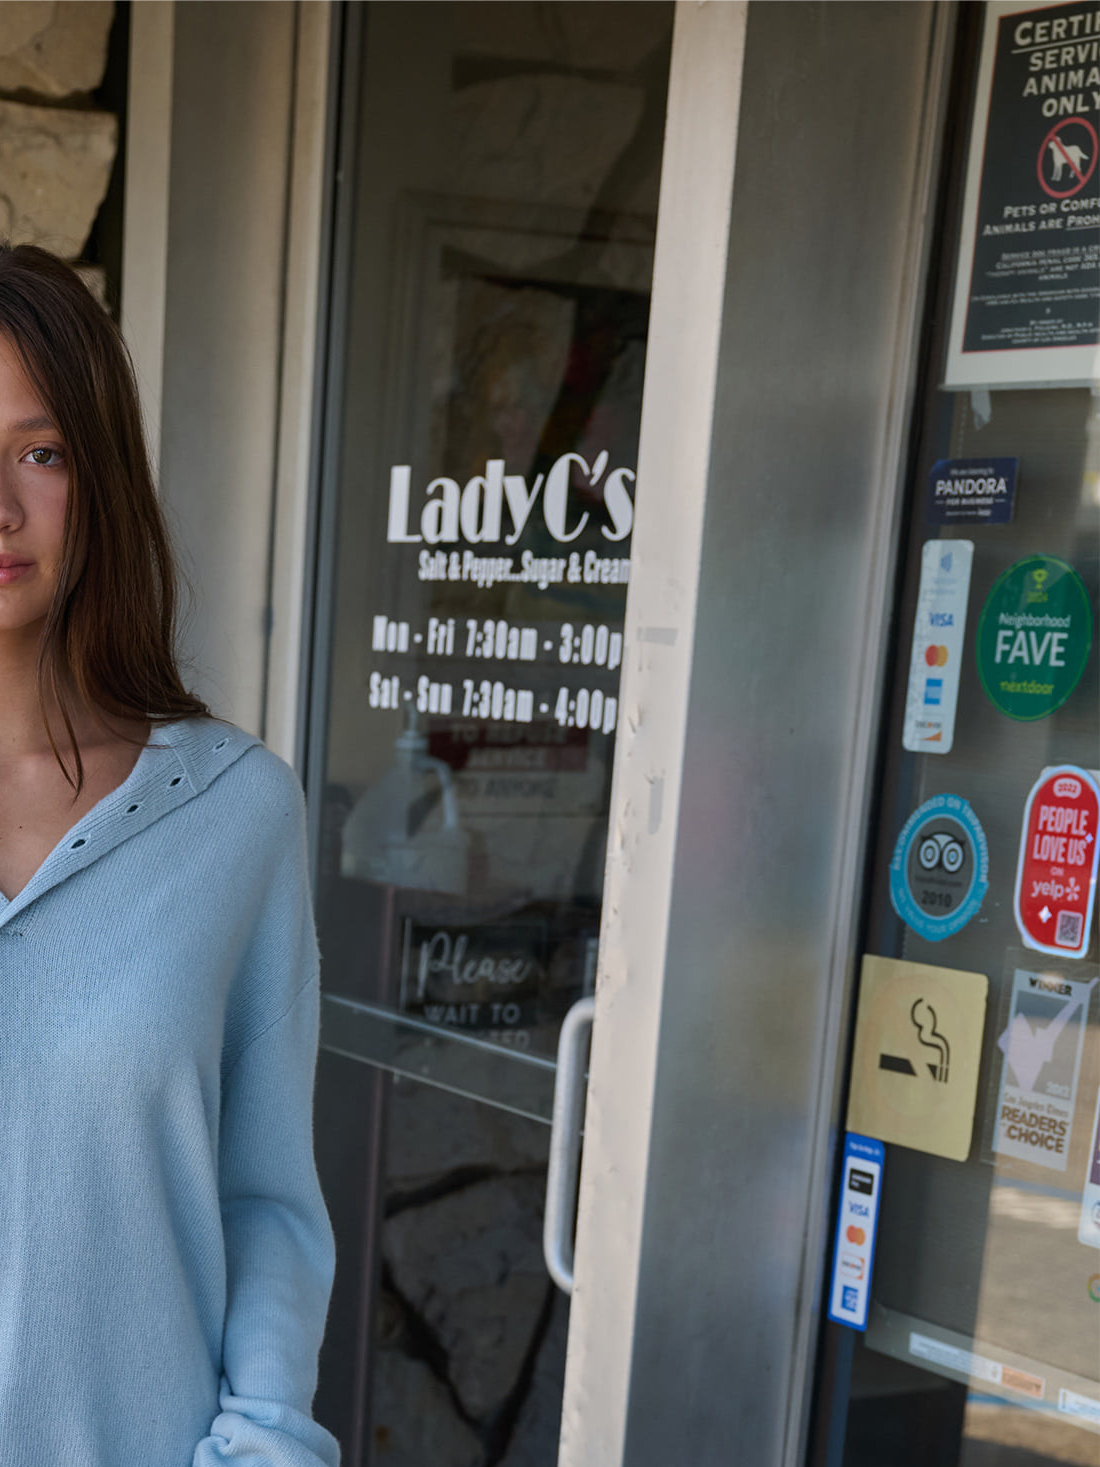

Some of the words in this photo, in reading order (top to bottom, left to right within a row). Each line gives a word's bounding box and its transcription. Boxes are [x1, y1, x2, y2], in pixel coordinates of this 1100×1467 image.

[1028, 42, 1100, 71] SERVI
[1042, 91, 1100, 117] ONLY
[1003, 205, 1037, 219] PETS
[1039, 202, 1058, 215] OR
[982, 221, 1036, 237] ANIMALS
[1038, 218, 1064, 230] ARE
[935, 477, 1007, 496] PANDORA
[418, 550, 447, 581] Salt
[448, 551, 461, 581] &
[567, 551, 582, 584] &
[999, 612, 1071, 629] Neighborhood
[372, 615, 410, 653] Mon
[427, 617, 456, 656] Fri
[465, 618, 538, 661] 7:30am
[559, 623, 623, 671] 3:00p
[995, 630, 1068, 667] FAVE
[1000, 680, 1055, 695] nextdoor
[369, 672, 399, 709] Sat
[417, 675, 453, 715] Sun
[462, 679, 534, 723] 7:30am
[554, 687, 618, 735] 4:00p
[1038, 805, 1089, 836] PEOPLE
[1032, 834, 1067, 863] LOVE
[1067, 838, 1087, 866] US
[1031, 879, 1065, 900] yelp
[416, 931, 532, 999] Please
[424, 1003, 480, 1024] WAIT
[489, 1003, 521, 1025] TO
[1007, 1124, 1065, 1155] CHOICE
